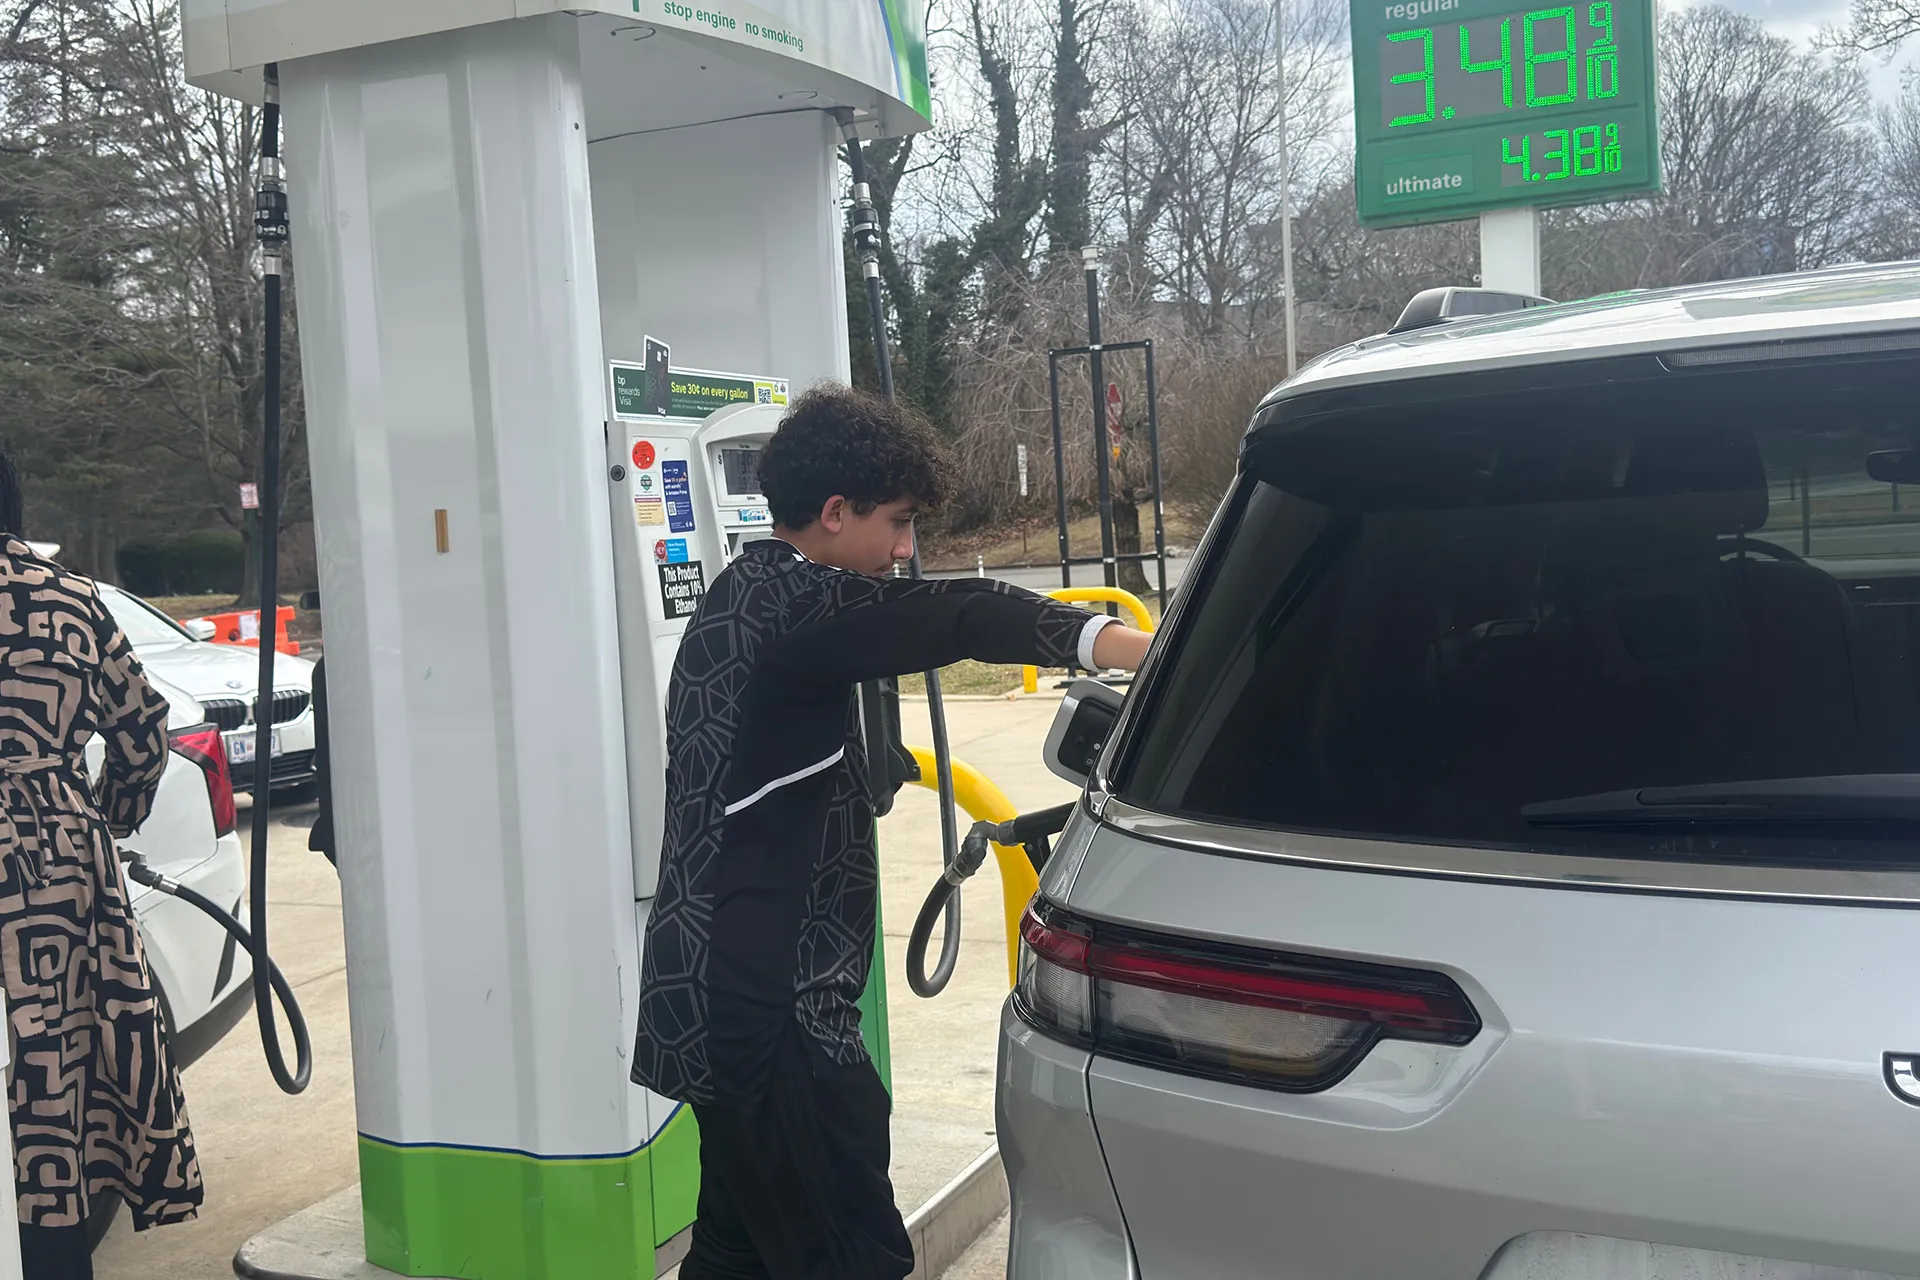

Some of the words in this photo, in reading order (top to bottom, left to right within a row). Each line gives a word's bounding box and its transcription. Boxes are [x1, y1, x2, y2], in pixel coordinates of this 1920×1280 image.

[664, 1, 693, 22] stop
[695, 9, 737, 30] engine
[1384, 0, 1459, 21] regular
[745, 22, 760, 36] no
[761, 27, 804, 52] smoking
[1386, 6, 1577, 127] 3.48
[1501, 125, 1601, 182] 4.38
[1386, 172, 1463, 196] ultimate
[617, 375, 626, 386] bp
[618, 387, 640, 397] rewards
[670, 381, 687, 394] Save
[687, 383, 701, 395] 30¢
[701, 387, 710, 396] on
[711, 388, 728, 400] every
[619, 396, 632, 406] Visa
[663, 566, 677, 583] This
[676, 564, 700, 582] Product
[664, 582, 690, 599] Contains
[690, 580, 703, 596] 10%
[674, 596, 698, 615] Ethanol
